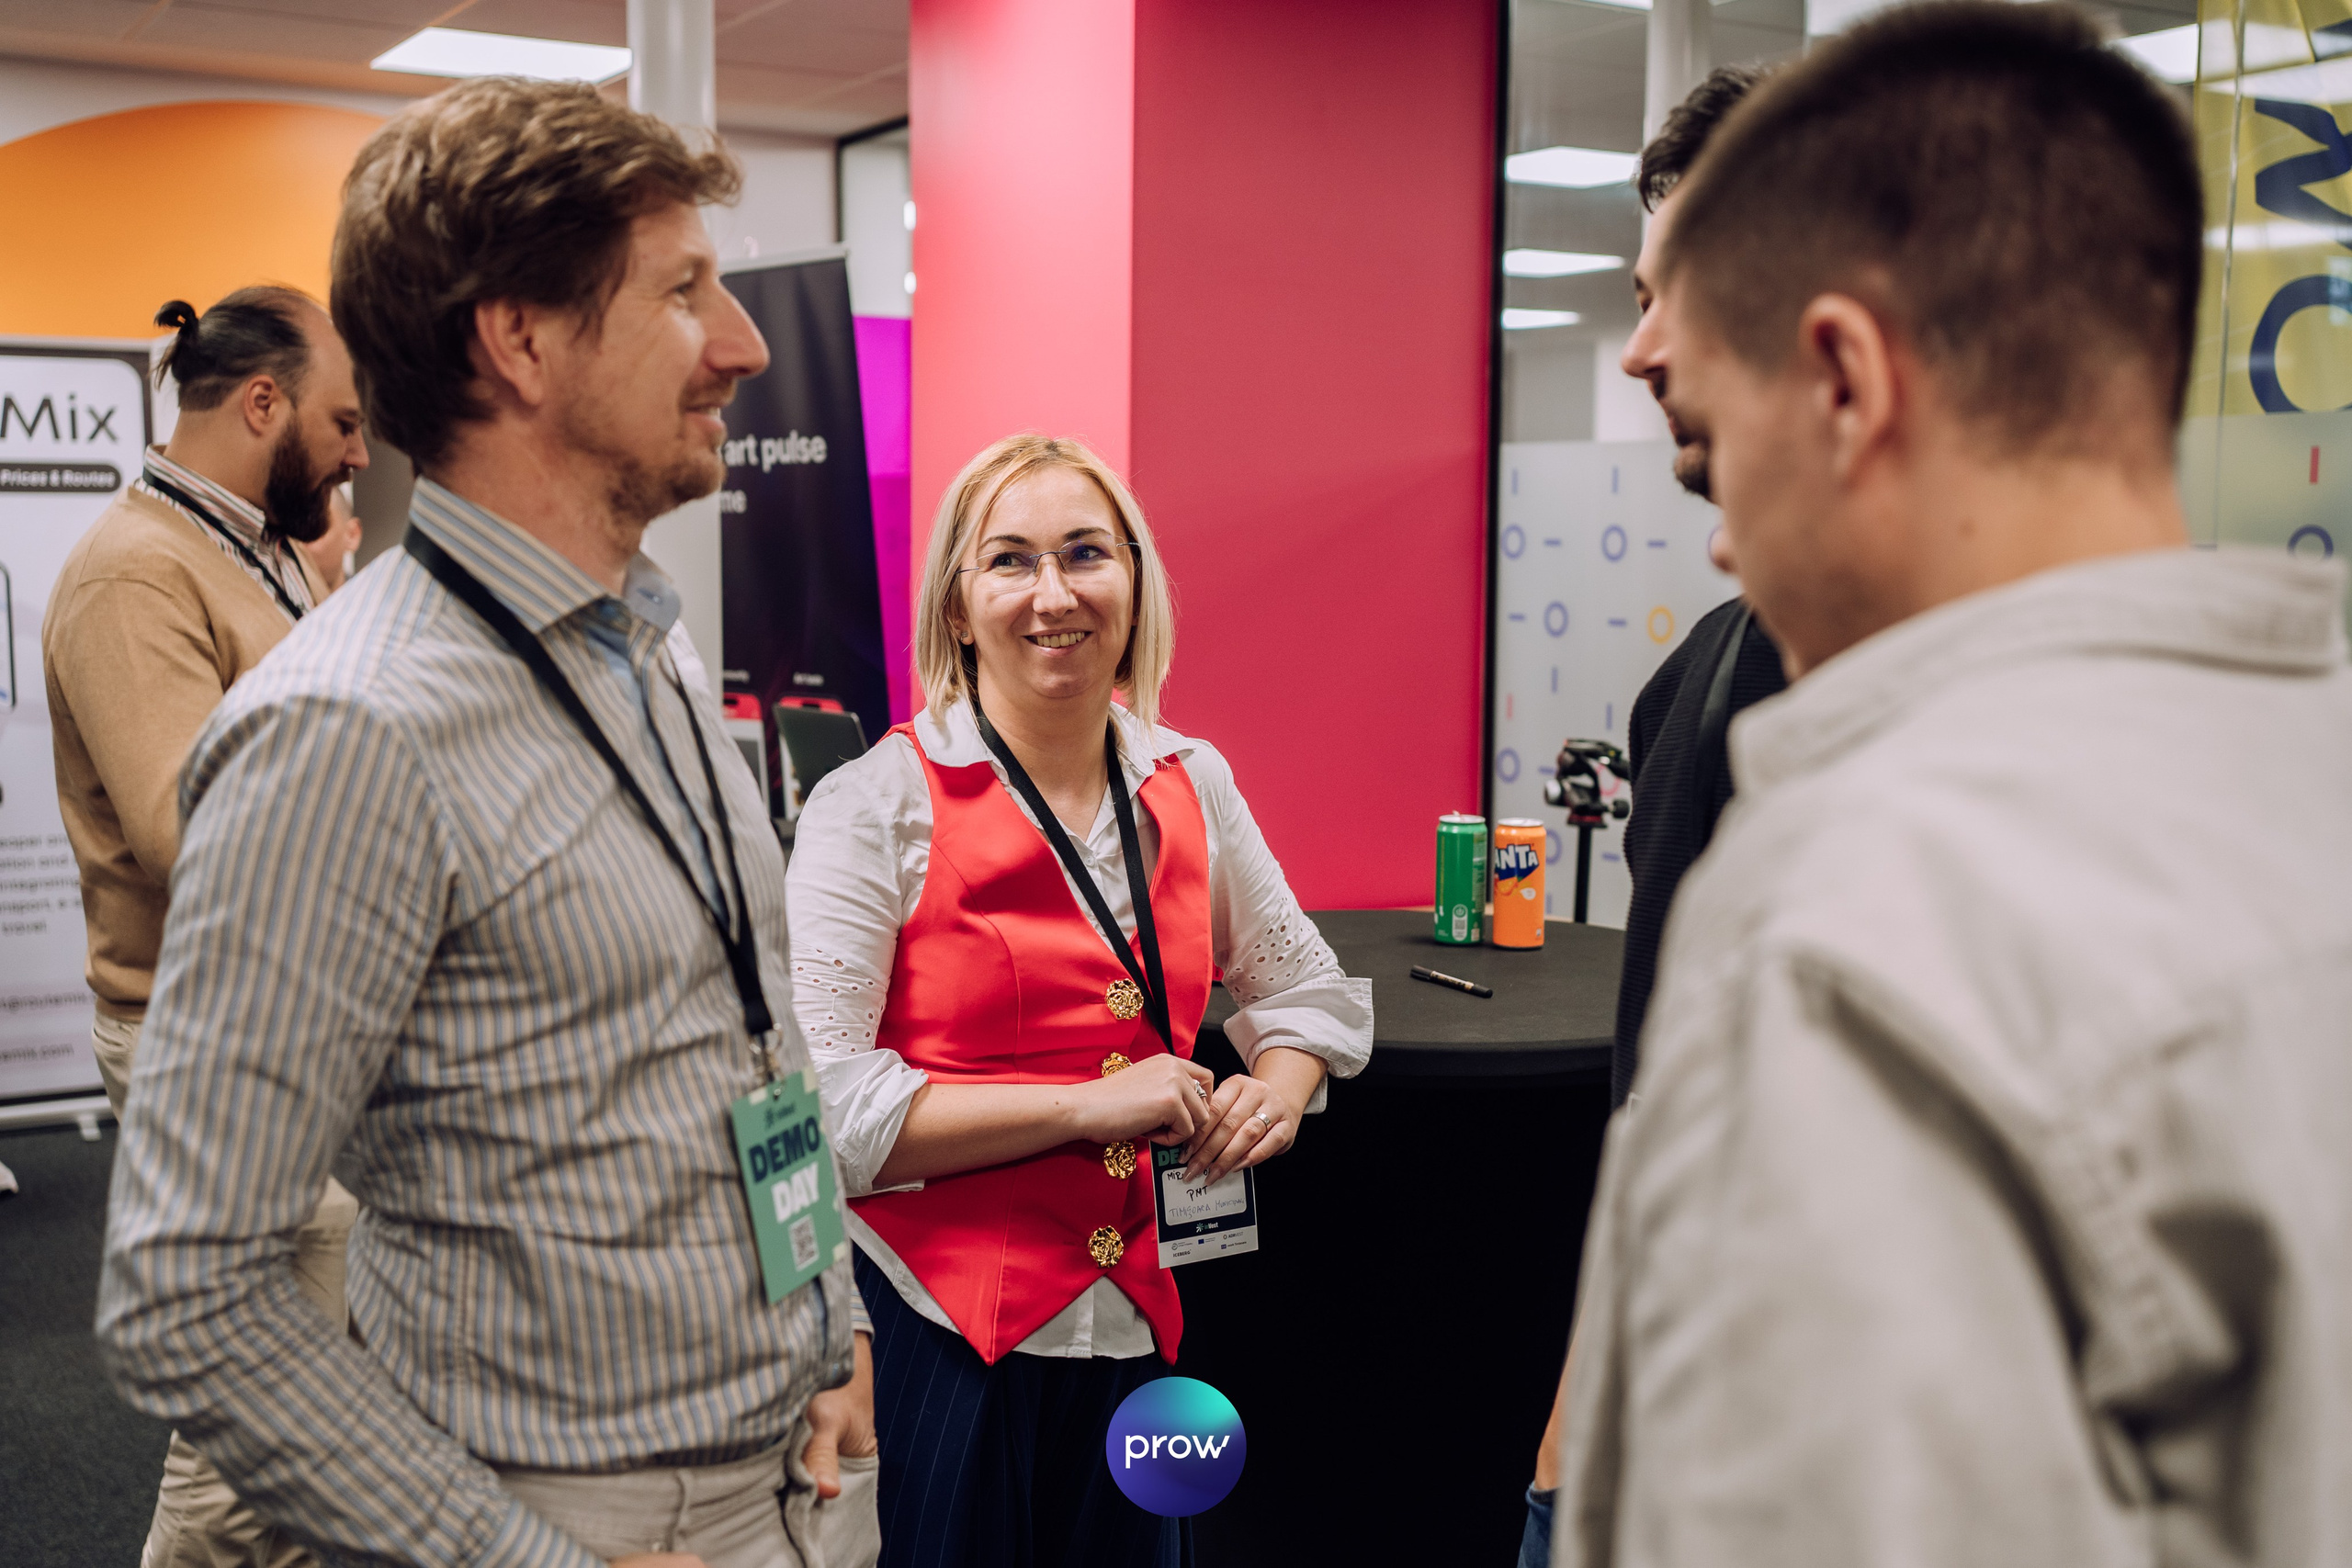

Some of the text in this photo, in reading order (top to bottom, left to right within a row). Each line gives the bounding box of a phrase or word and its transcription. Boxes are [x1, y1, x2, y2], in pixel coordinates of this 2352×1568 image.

[1, 392, 118, 442] Mix
[761, 429, 827, 473] pulse
[749, 1114, 820, 1184] DEMO
[771, 1161, 820, 1223] DAY
